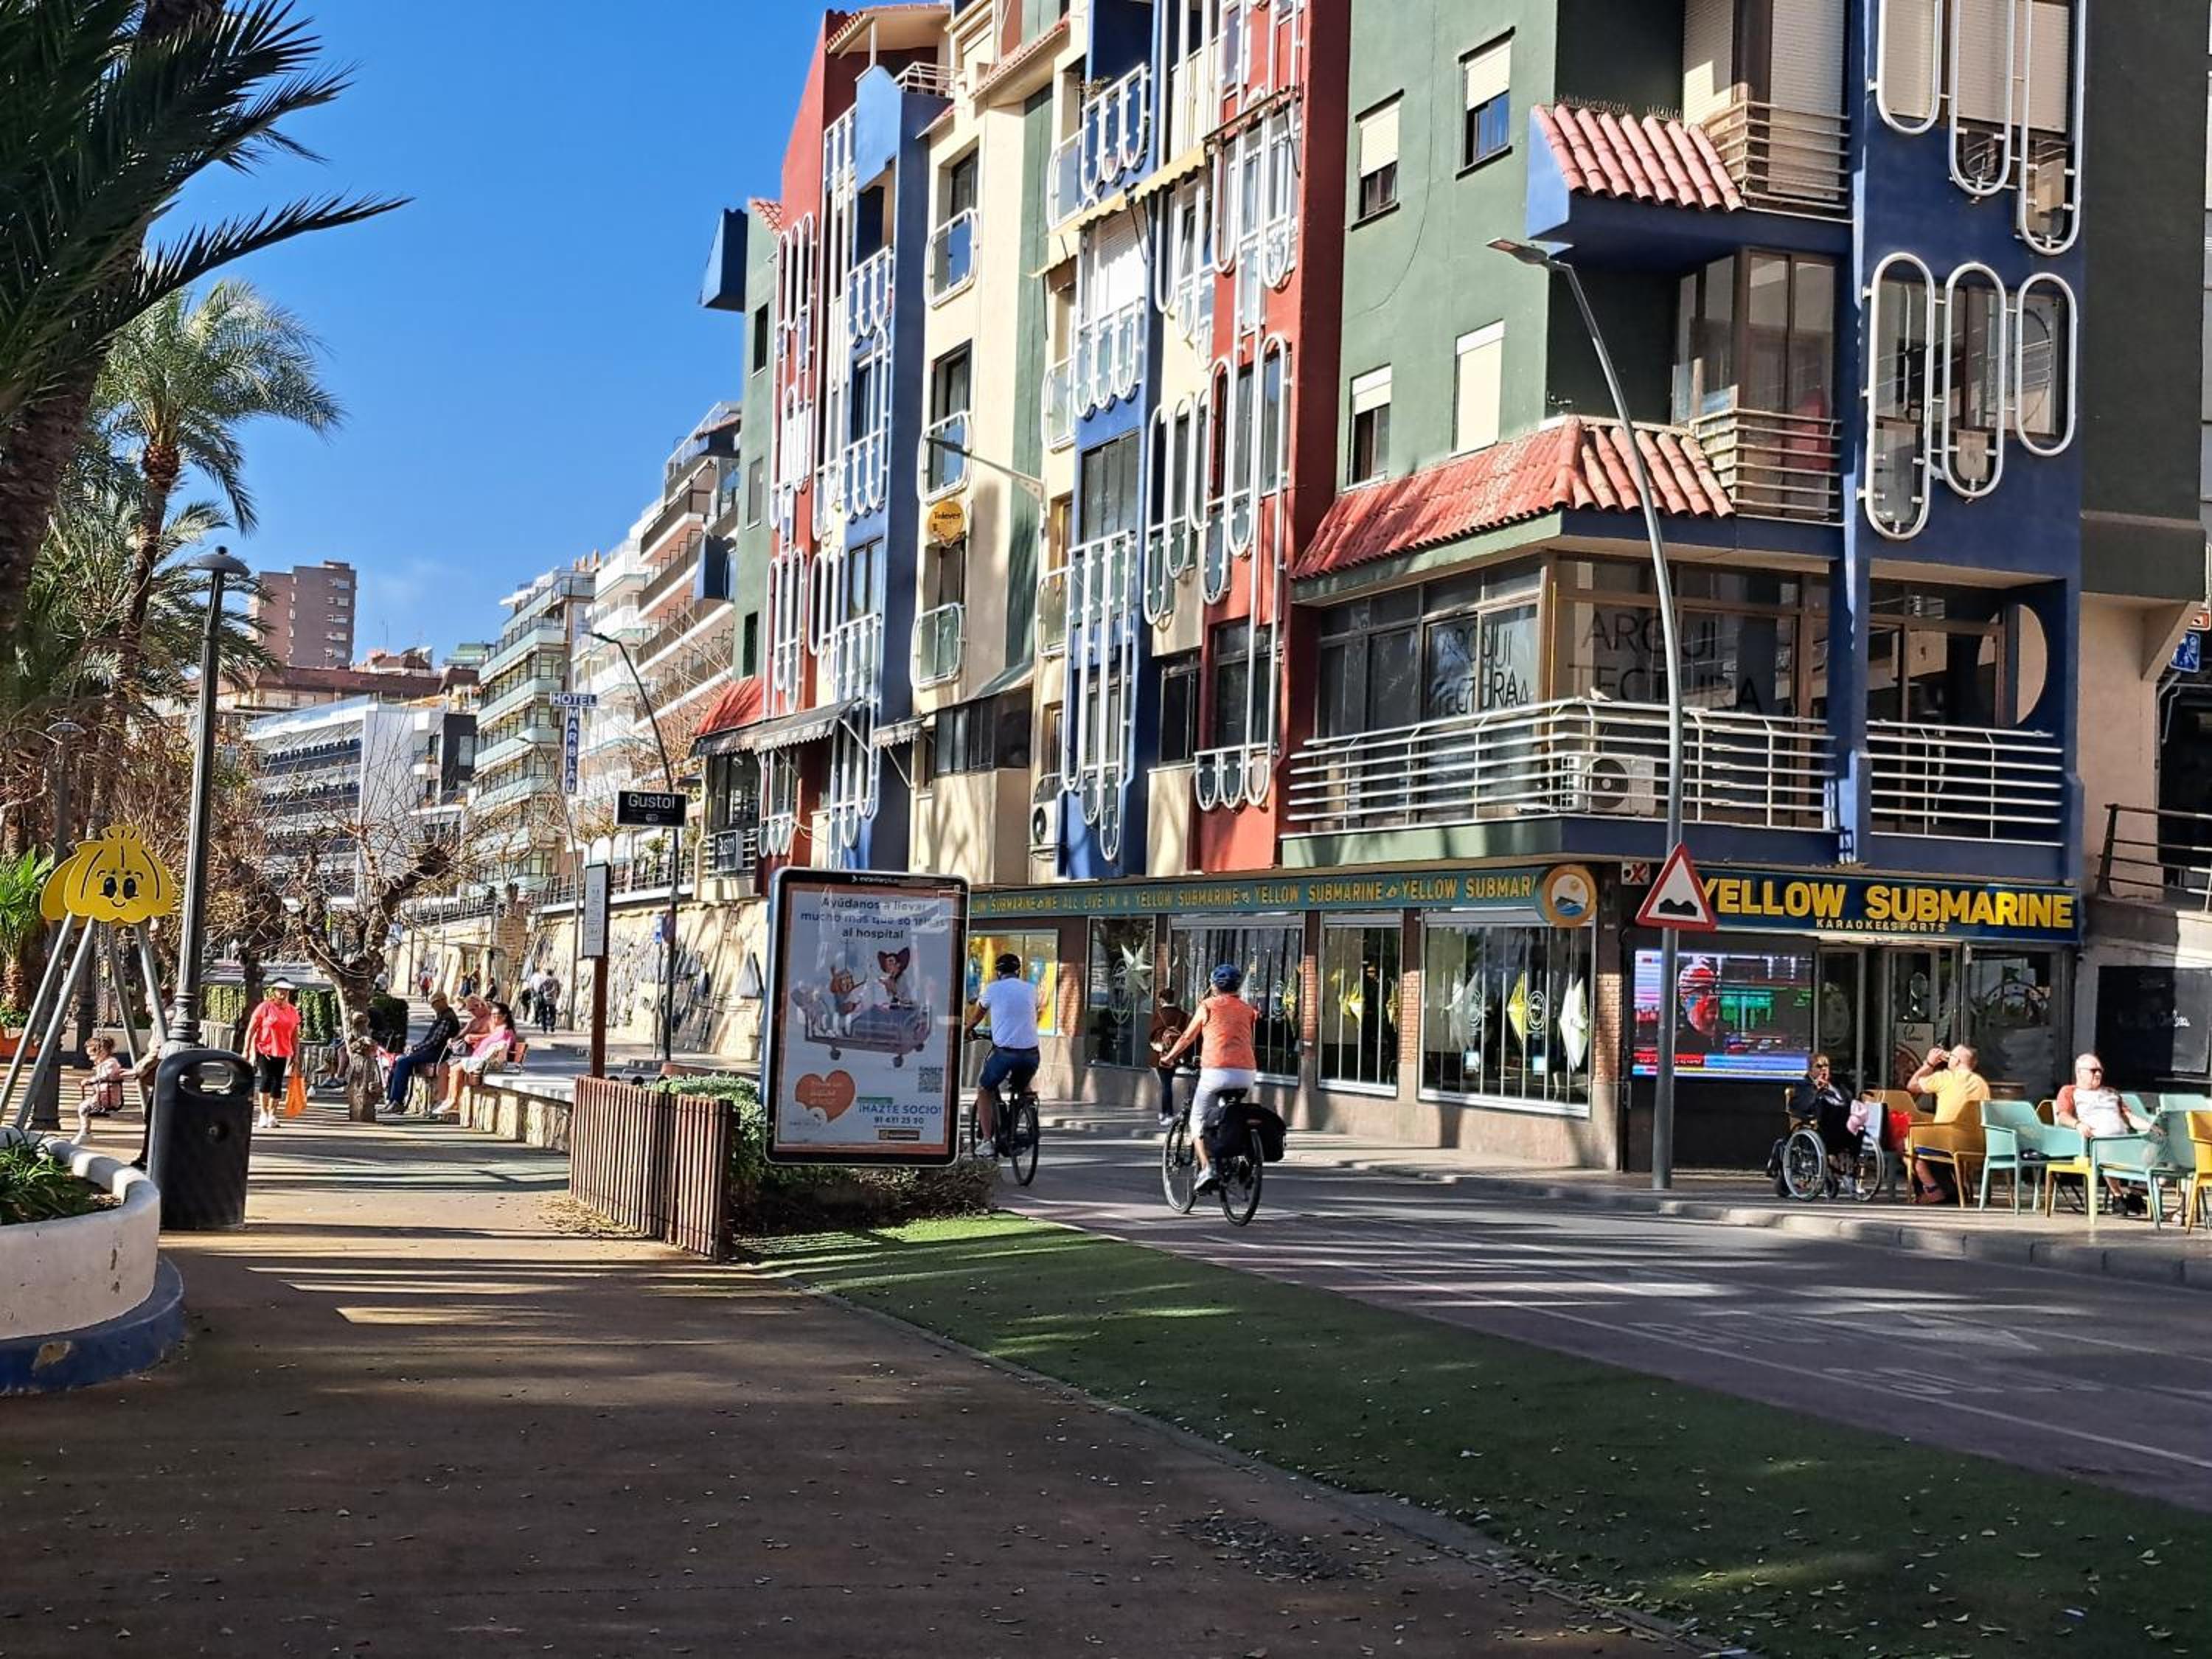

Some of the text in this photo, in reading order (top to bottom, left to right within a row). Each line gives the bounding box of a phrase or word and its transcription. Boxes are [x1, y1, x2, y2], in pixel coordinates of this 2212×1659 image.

[1582, 611, 1716, 659] ARQUI
[553, 694, 594, 706] HOTEL
[991, 894, 1037, 912] SUBMARINE
[1135, 890, 1172, 908] YELLOW
[1178, 887, 1239, 907] SUBMARINE
[1254, 884, 1300, 904] YELLOW
[1308, 881, 1383, 902] SUBMARINE
[1402, 877, 1458, 900] YELLOW
[821, 897, 880, 911] Ayúdanos
[1697, 877, 2074, 928] YELLOW SUBMARINE
[843, 928, 904, 940] al hospital
[903, 1105, 942, 1116] SOCIO!
